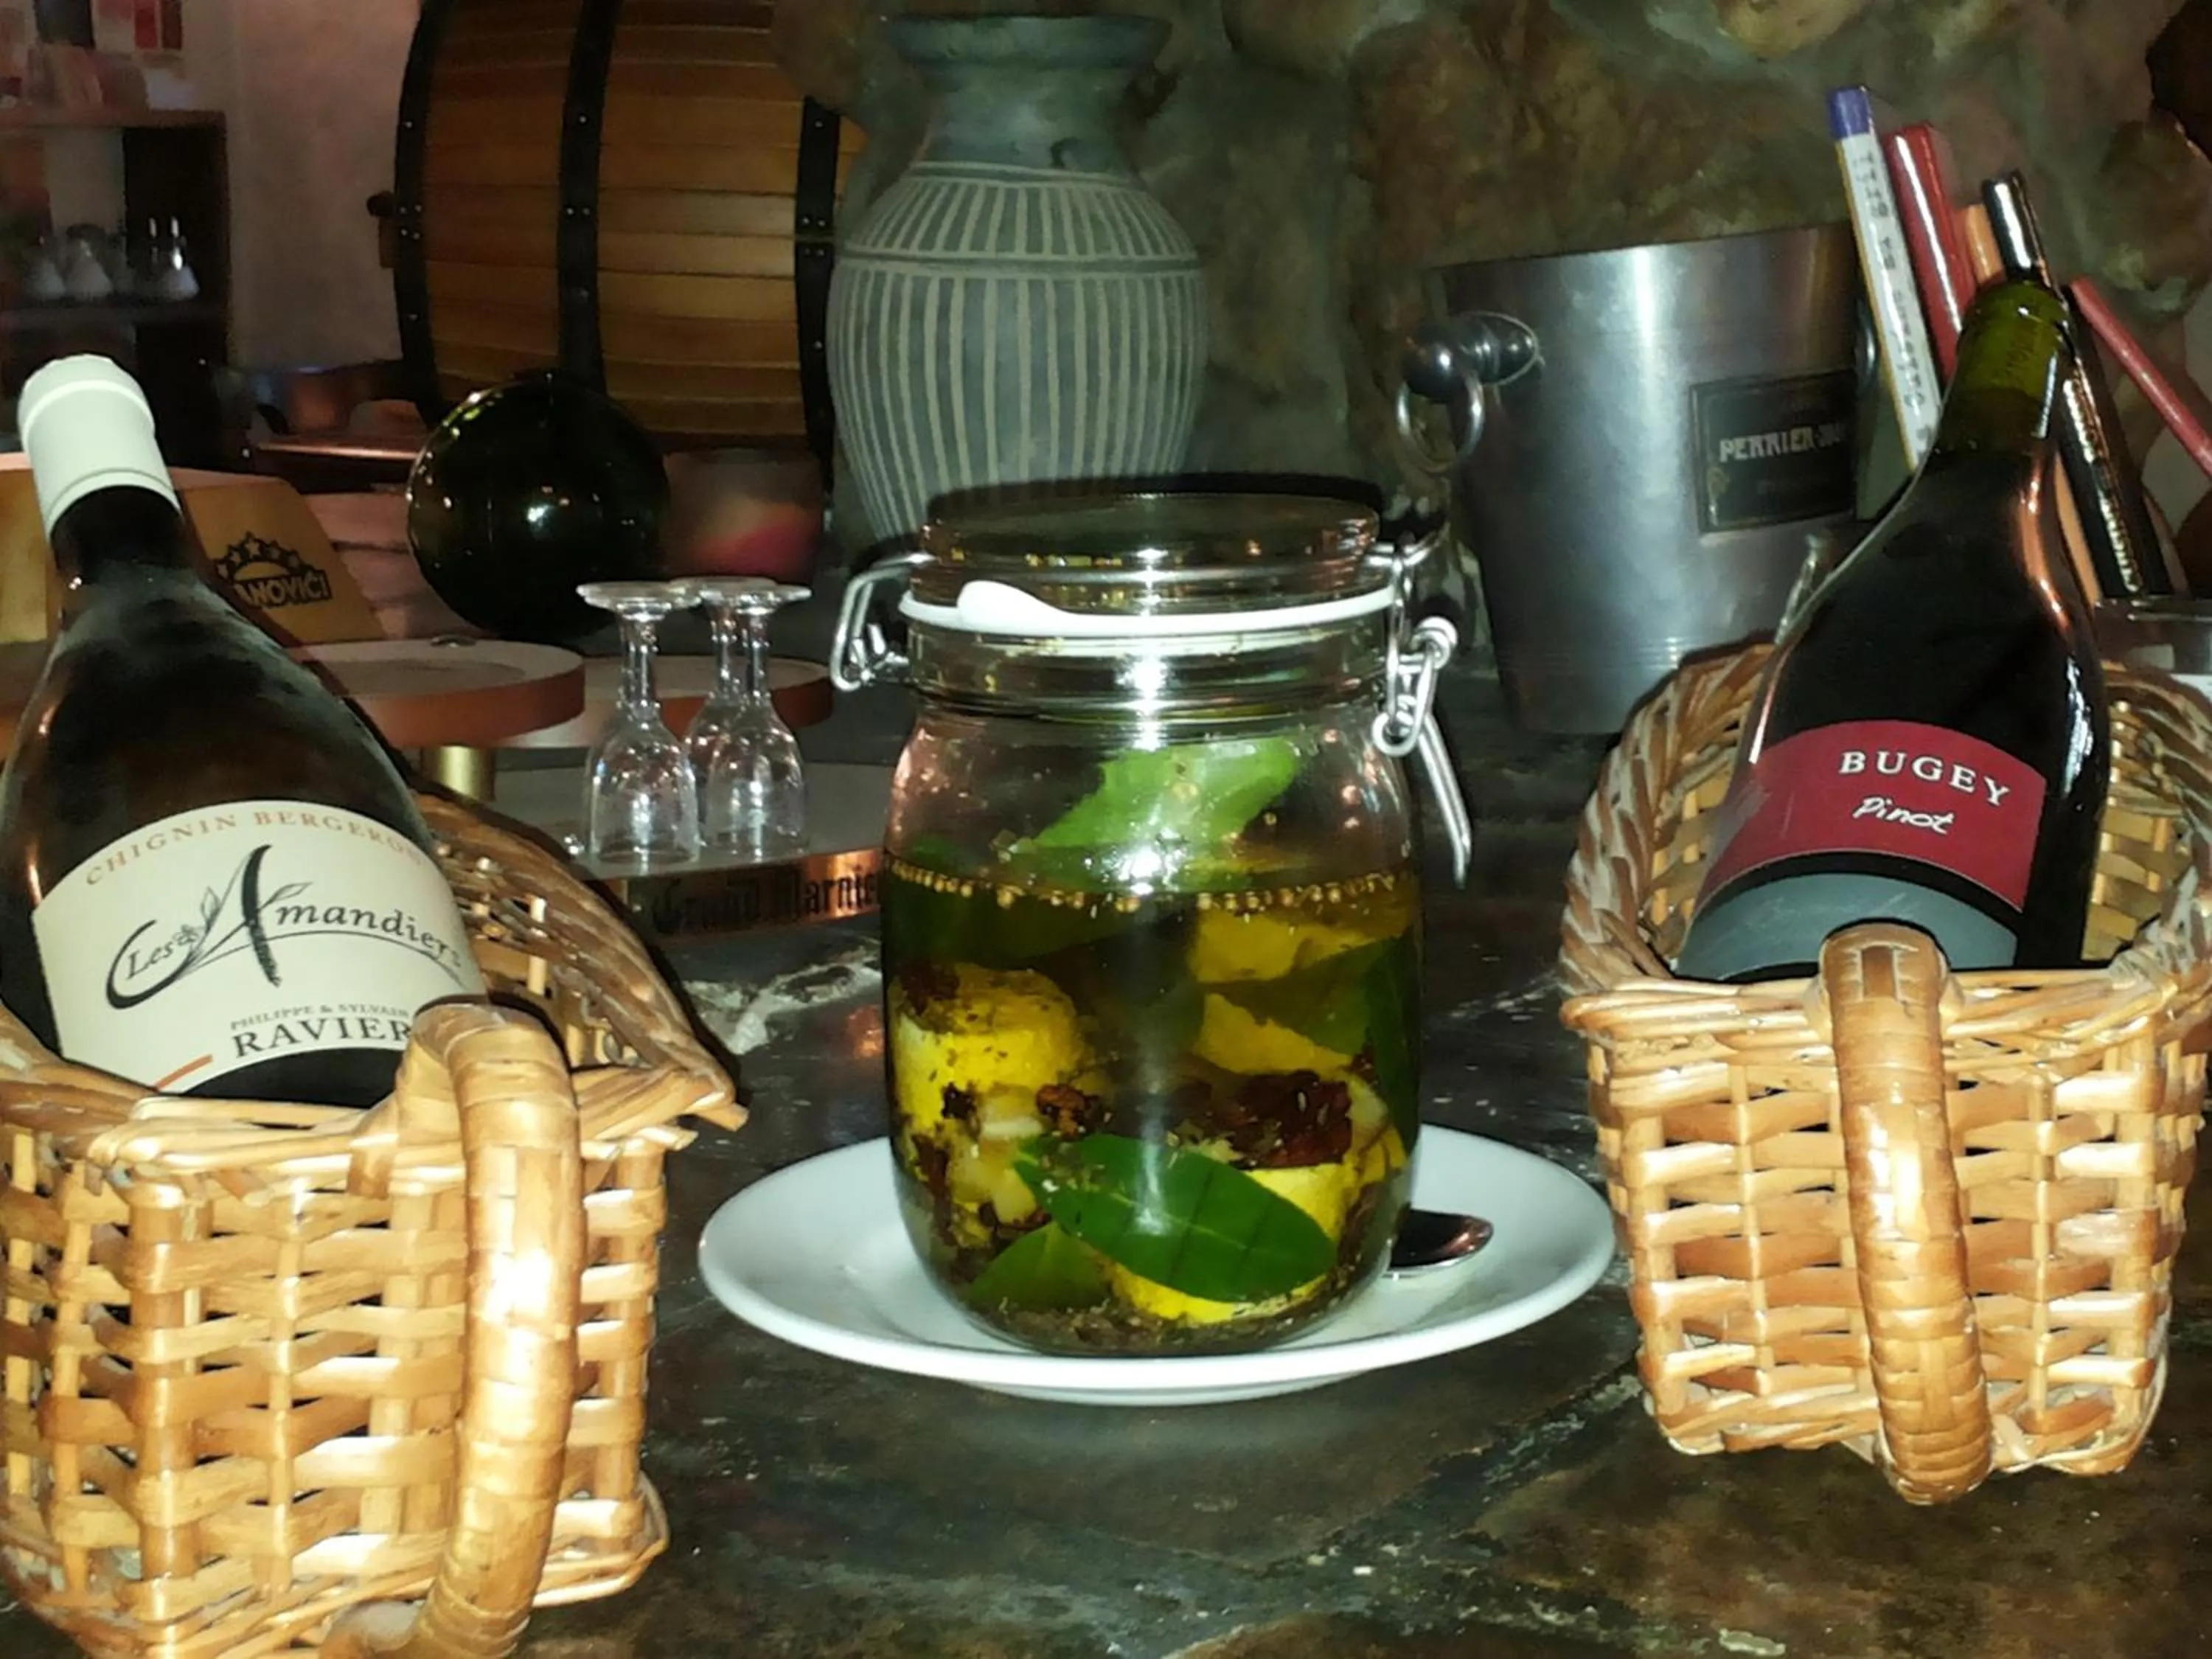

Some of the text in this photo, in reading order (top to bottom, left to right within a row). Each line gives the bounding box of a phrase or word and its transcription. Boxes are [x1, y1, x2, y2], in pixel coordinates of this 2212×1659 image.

[1839, 751, 2010, 806] BUGEY
[1852, 796, 1955, 834] Pinot
[86, 813, 237, 886] CHIGNIN
[126, 844, 462, 987] Les Amandiers
[231, 1004, 315, 1031] PHILIPPE
[319, 1004, 333, 1014] &
[232, 1016, 411, 1058] RAVIER
